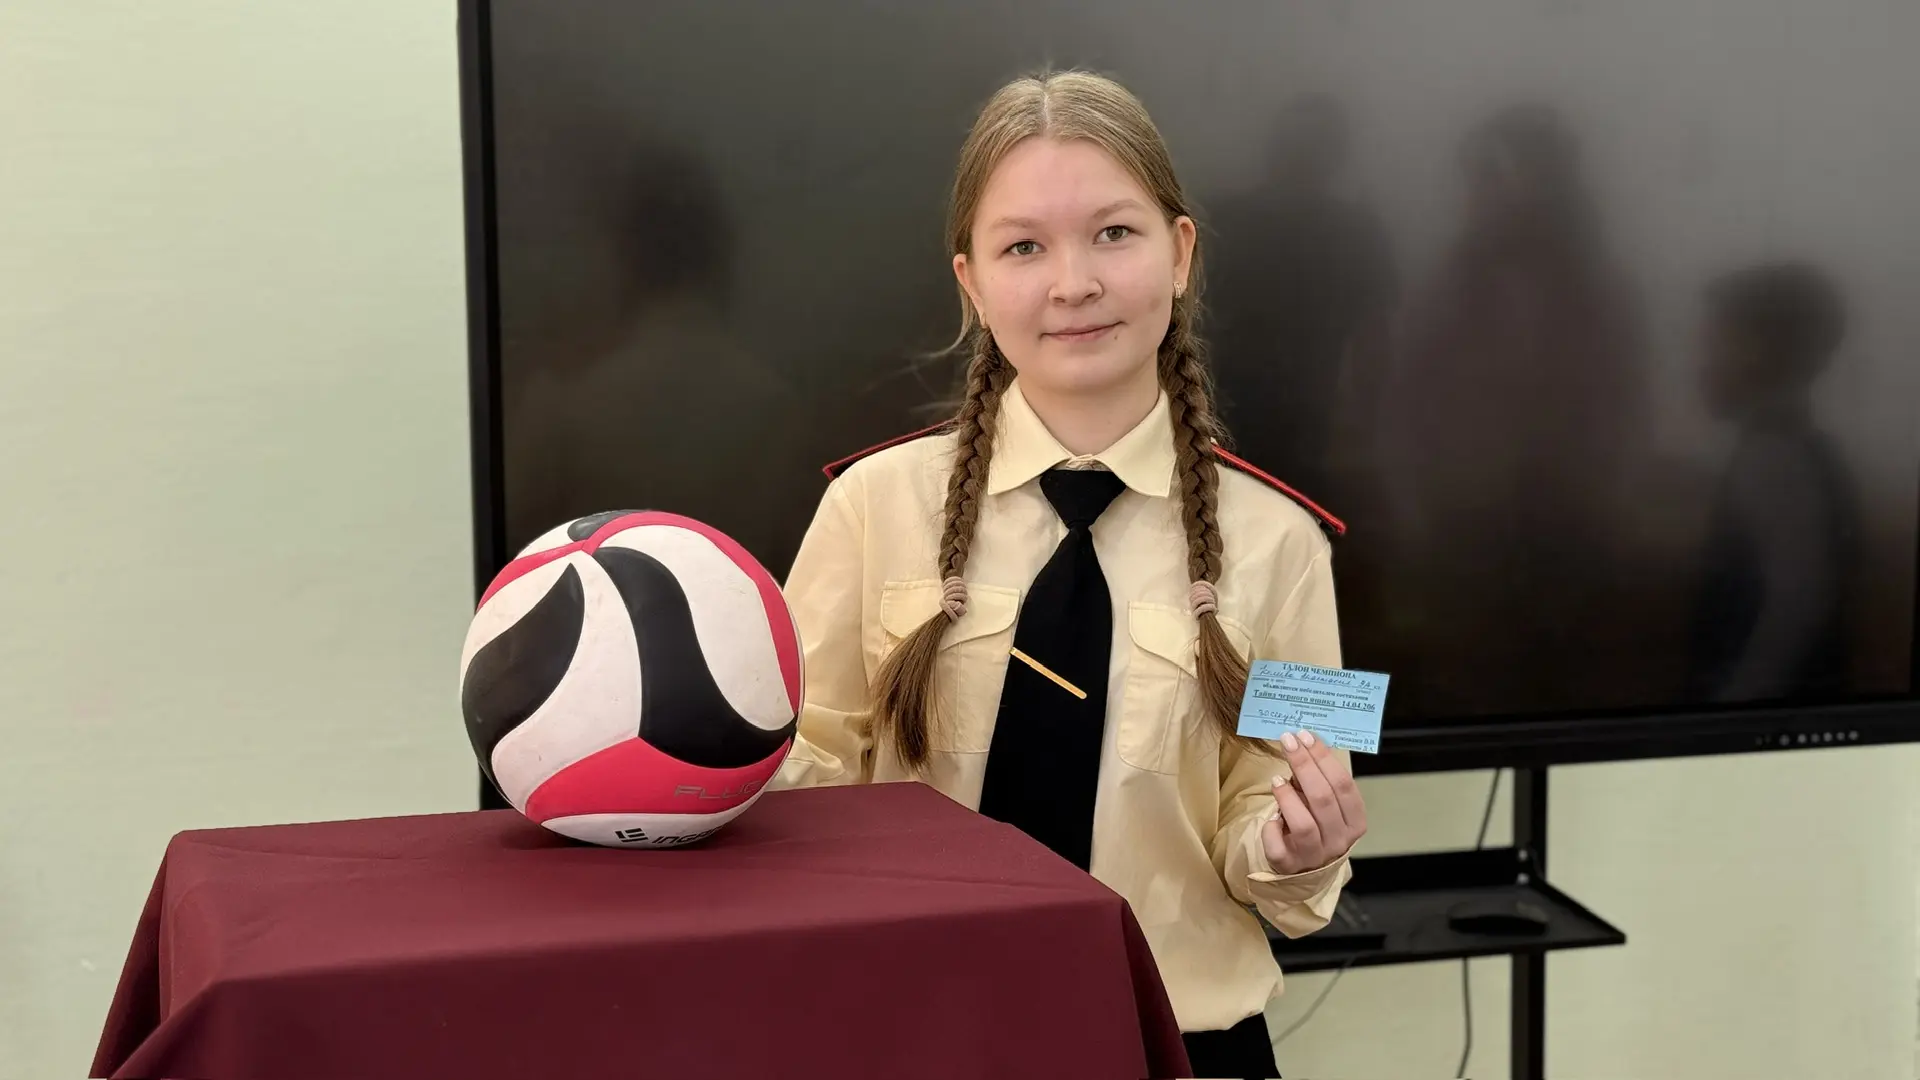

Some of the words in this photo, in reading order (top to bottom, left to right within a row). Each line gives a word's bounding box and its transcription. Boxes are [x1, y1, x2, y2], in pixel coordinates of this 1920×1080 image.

[1282, 663, 1310, 673] ТАЛОН
[1311, 667, 1356, 680] ЧЕМПИОНА
[1253, 689, 1277, 699] Тайна
[1278, 693, 1309, 704] черного
[1309, 697, 1336, 707] ящика
